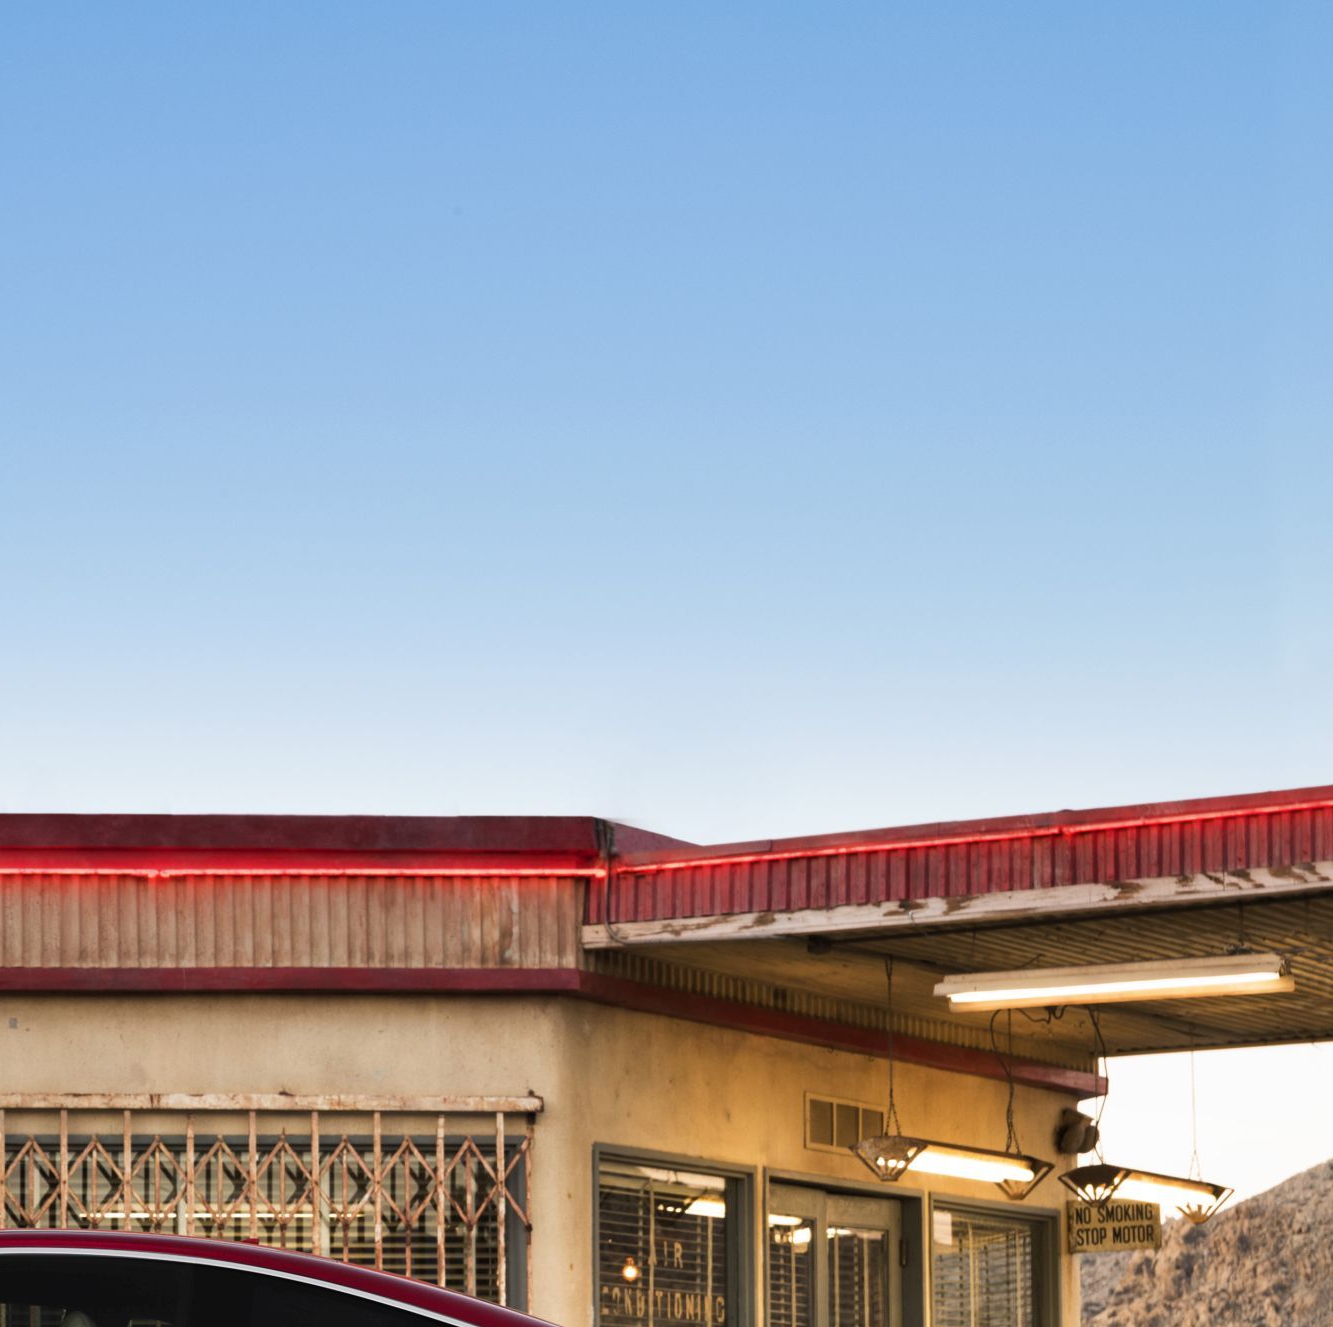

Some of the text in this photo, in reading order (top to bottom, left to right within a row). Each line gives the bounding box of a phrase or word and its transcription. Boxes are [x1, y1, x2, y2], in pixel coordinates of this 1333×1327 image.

[1075, 1202, 1154, 1225] NO SMOKING
[1076, 1224, 1155, 1247] STOP MOTOR
